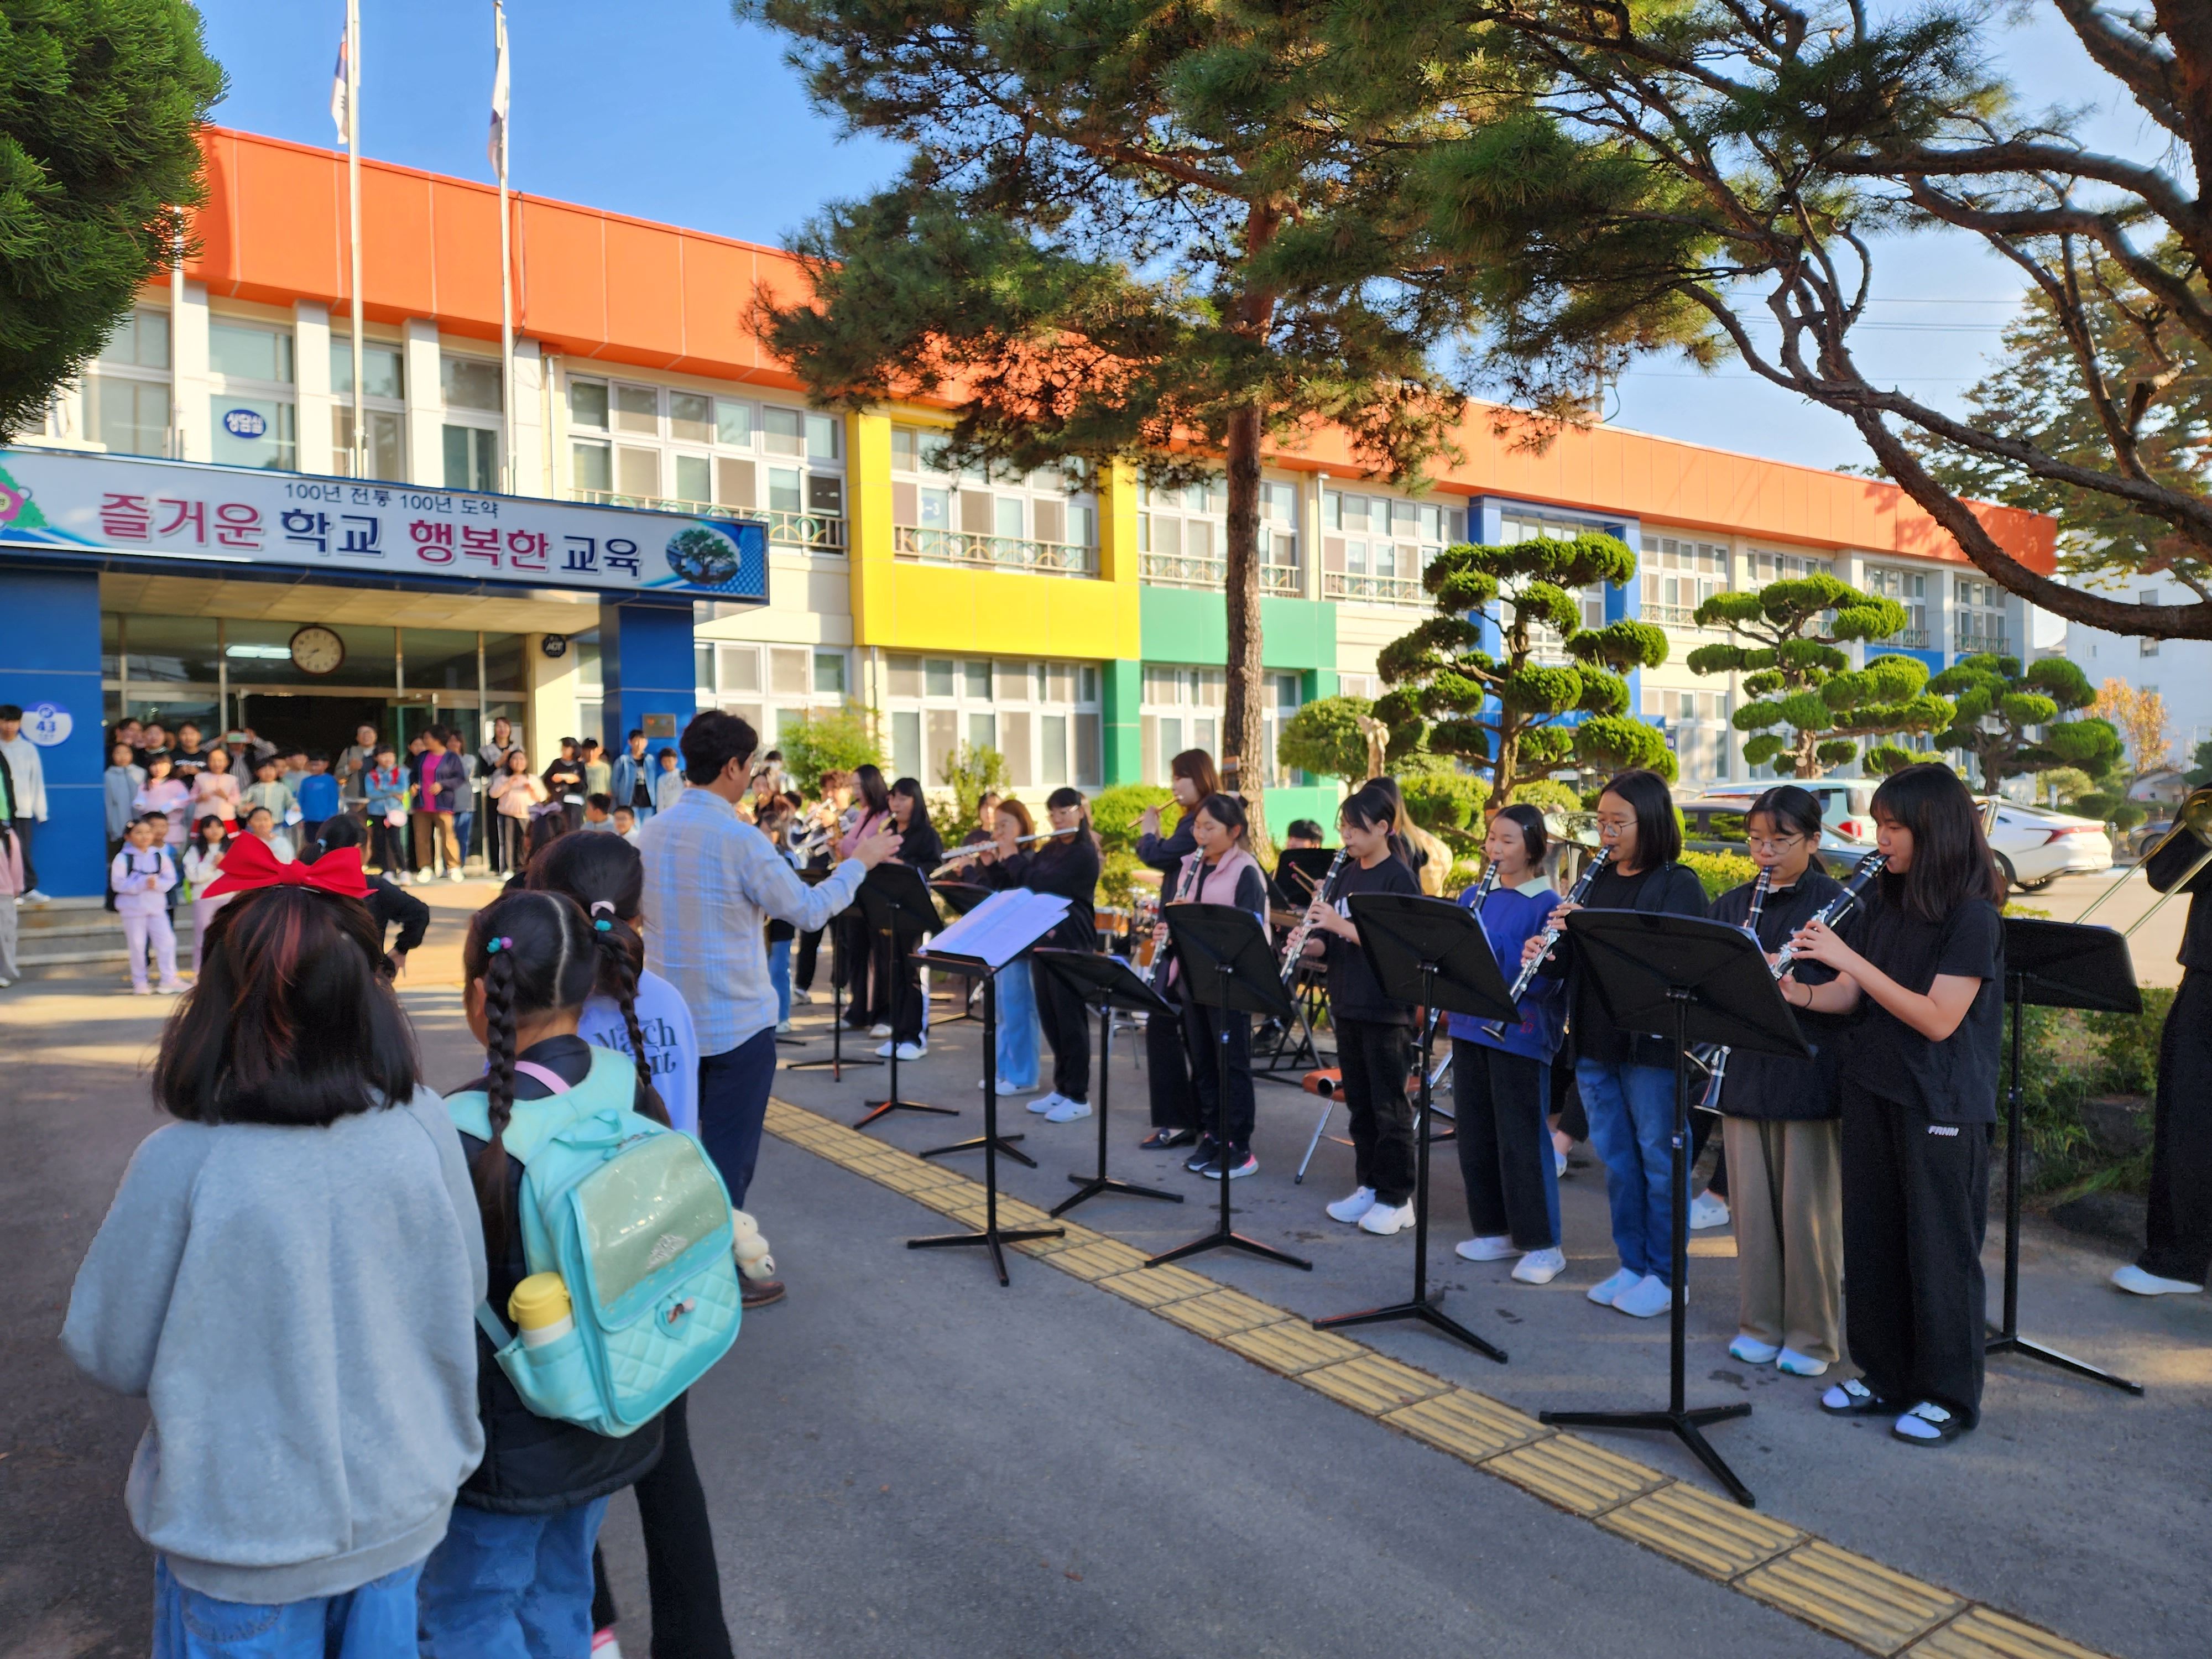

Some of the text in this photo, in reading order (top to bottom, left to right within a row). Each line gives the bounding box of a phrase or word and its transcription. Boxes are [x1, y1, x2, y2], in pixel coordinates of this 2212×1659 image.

[227, 412, 263, 434] 상담실
[285, 482, 498, 518] 100년 전통 100년 도약
[100, 492, 640, 578] 즐거운 학교 행복한 교육
